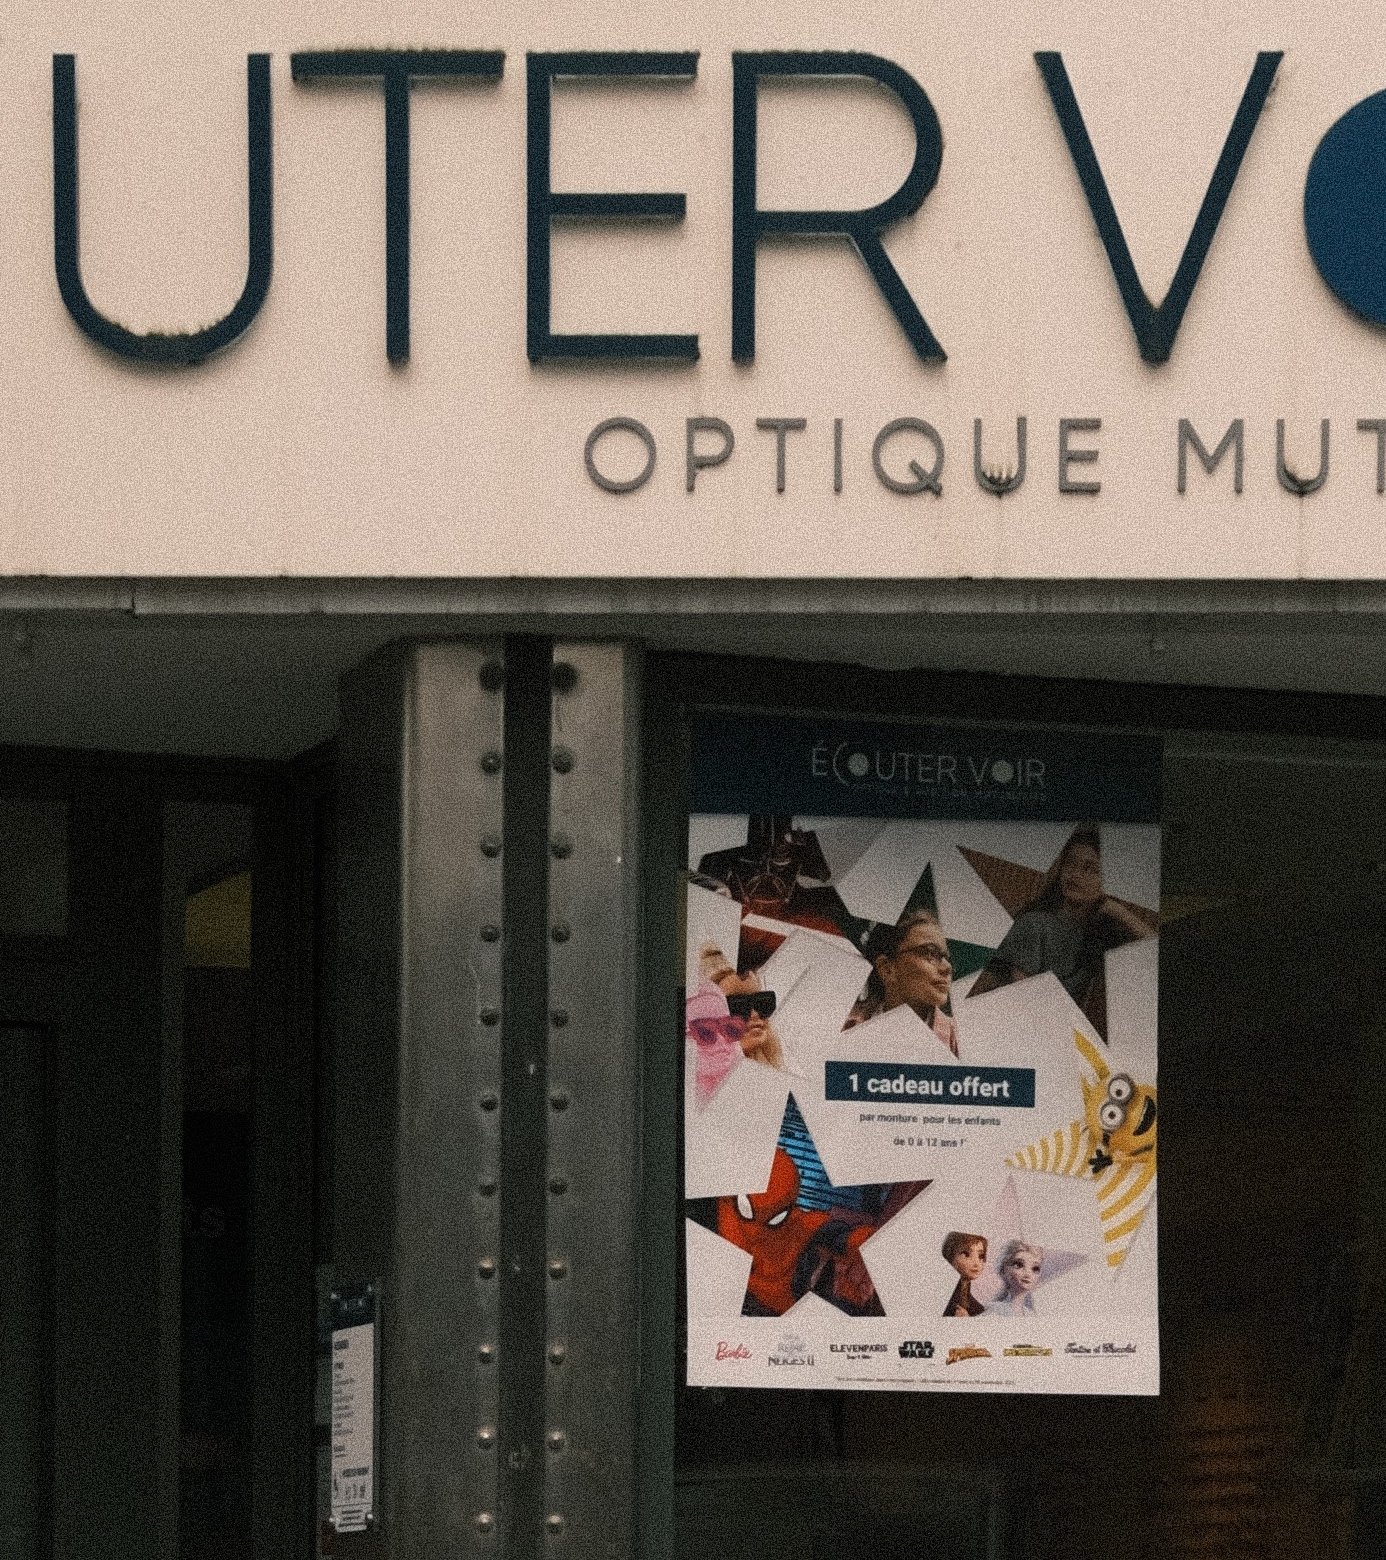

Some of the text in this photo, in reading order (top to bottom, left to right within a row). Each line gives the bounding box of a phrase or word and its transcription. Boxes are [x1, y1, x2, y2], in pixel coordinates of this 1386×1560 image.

[583, 416, 1102, 496] OPTIQUE
[967, 756, 1046, 788] VOIR
[848, 1073, 1011, 1099] 1 cadeau offert
